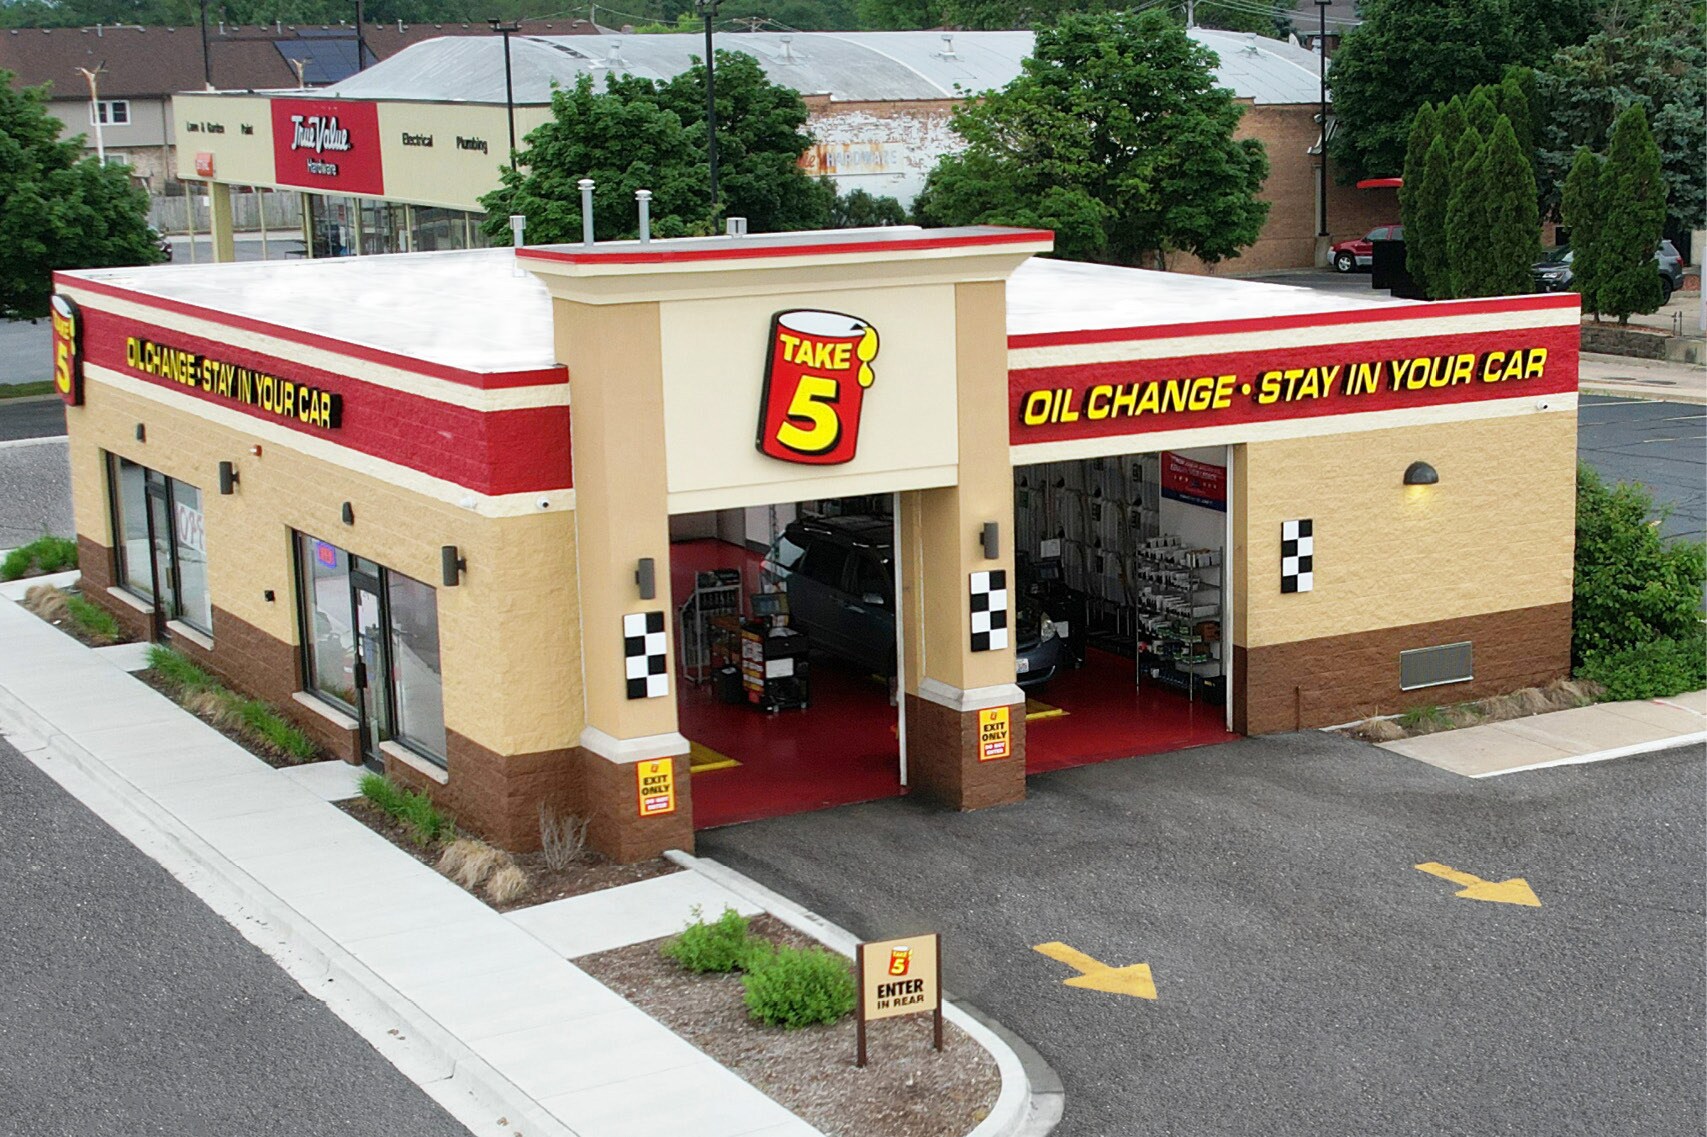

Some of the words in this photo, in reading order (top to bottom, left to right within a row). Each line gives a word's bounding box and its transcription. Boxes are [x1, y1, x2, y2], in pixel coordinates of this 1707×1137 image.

[291, 115, 315, 150] True
[308, 116, 351, 153] Value
[402, 132, 433, 147] Electrical
[456, 136, 488, 154] Plumbing
[307, 158, 337, 176] Hardware
[779, 333, 853, 370] TAKE
[56, 341, 71, 394] 5
[126, 336, 145, 371] OIL
[145, 342, 196, 388] CHANGE
[202, 358, 235, 398] STAY
[237, 367, 251, 405] IN
[255, 373, 295, 418] YOUR
[299, 386, 332, 430] CAR
[1023, 388, 1080, 426] OIL
[1087, 375, 1237, 420] CHANGE
[1258, 364, 1340, 405] STAY
[1345, 361, 1382, 396] IN
[1389, 353, 1476, 391] YOUR
[1482, 347, 1548, 383] CAR
[776, 375, 840, 452] 5
[984, 722, 1005, 731] EXIT
[982, 731, 1007, 741] ONLY
[644, 775, 667, 785] EXIT
[642, 785, 669, 795] ONLY
[891, 958, 905, 974] 5
[877, 978, 924, 999] ENTER
[877, 1000, 889, 1010] IN
[893, 994, 924, 1007] REAR
